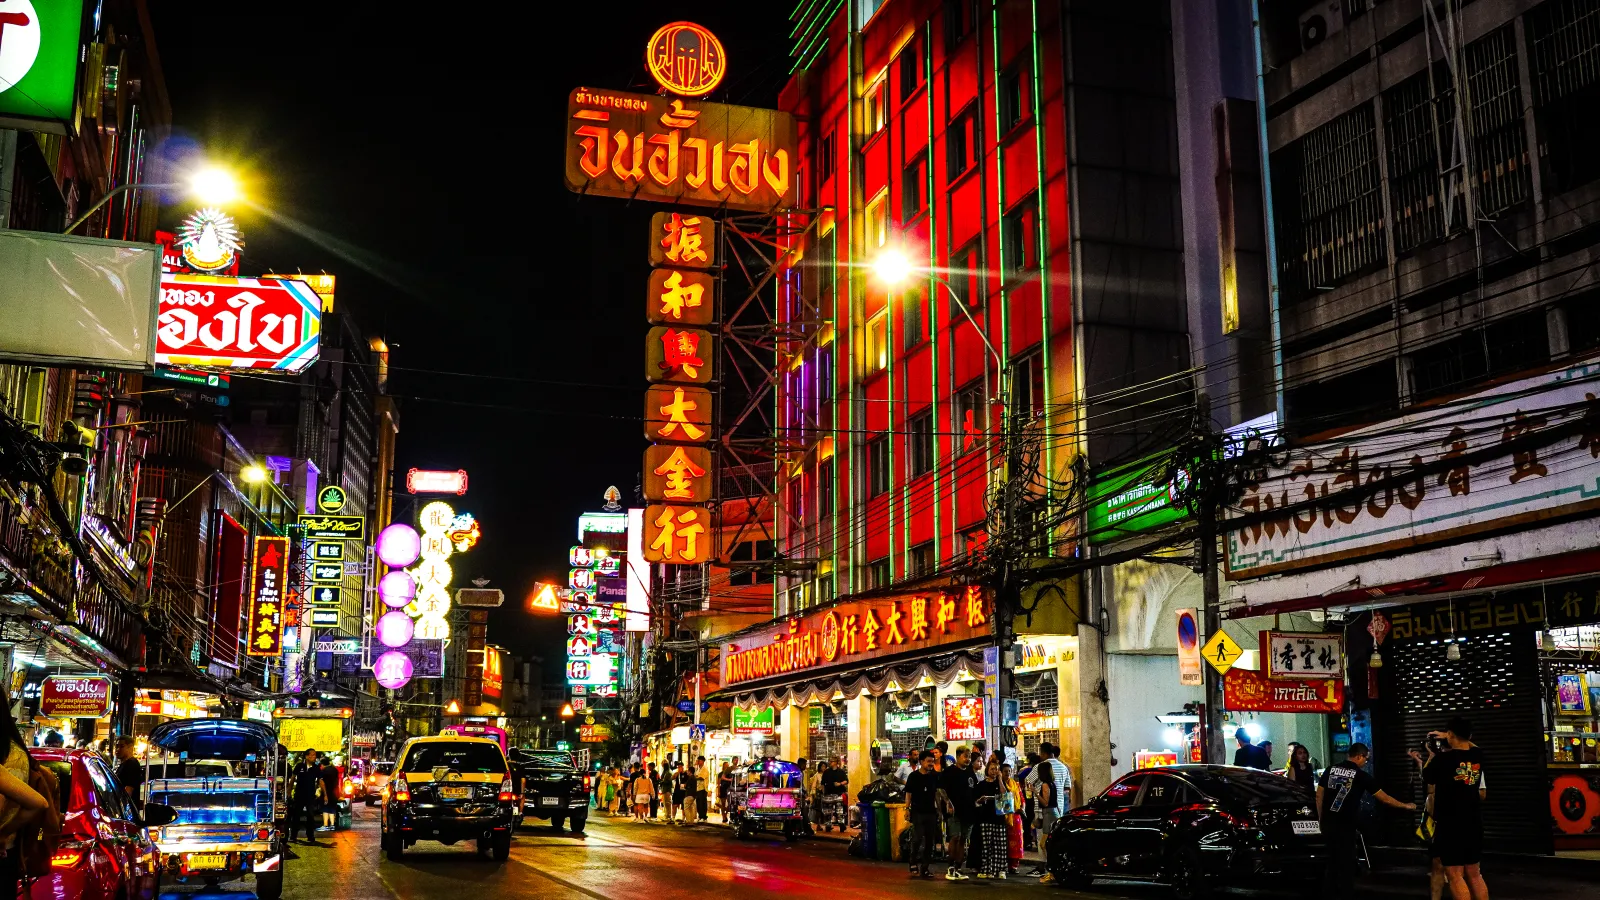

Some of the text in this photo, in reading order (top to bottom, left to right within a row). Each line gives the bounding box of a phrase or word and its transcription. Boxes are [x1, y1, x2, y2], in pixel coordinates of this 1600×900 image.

[576, 86, 648, 112] ห้างขายทอง
[573, 99, 790, 198] จินฮั้วเฮง
[160, 287, 215, 307] ทอง
[650, 212, 706, 560] 振和興大金行
[56, 679, 98, 693] ทองใบ
[1323, 680, 1338, 703] 1
[582, 727, 593, 737] 24
[1329, 766, 1357, 779] POWER
